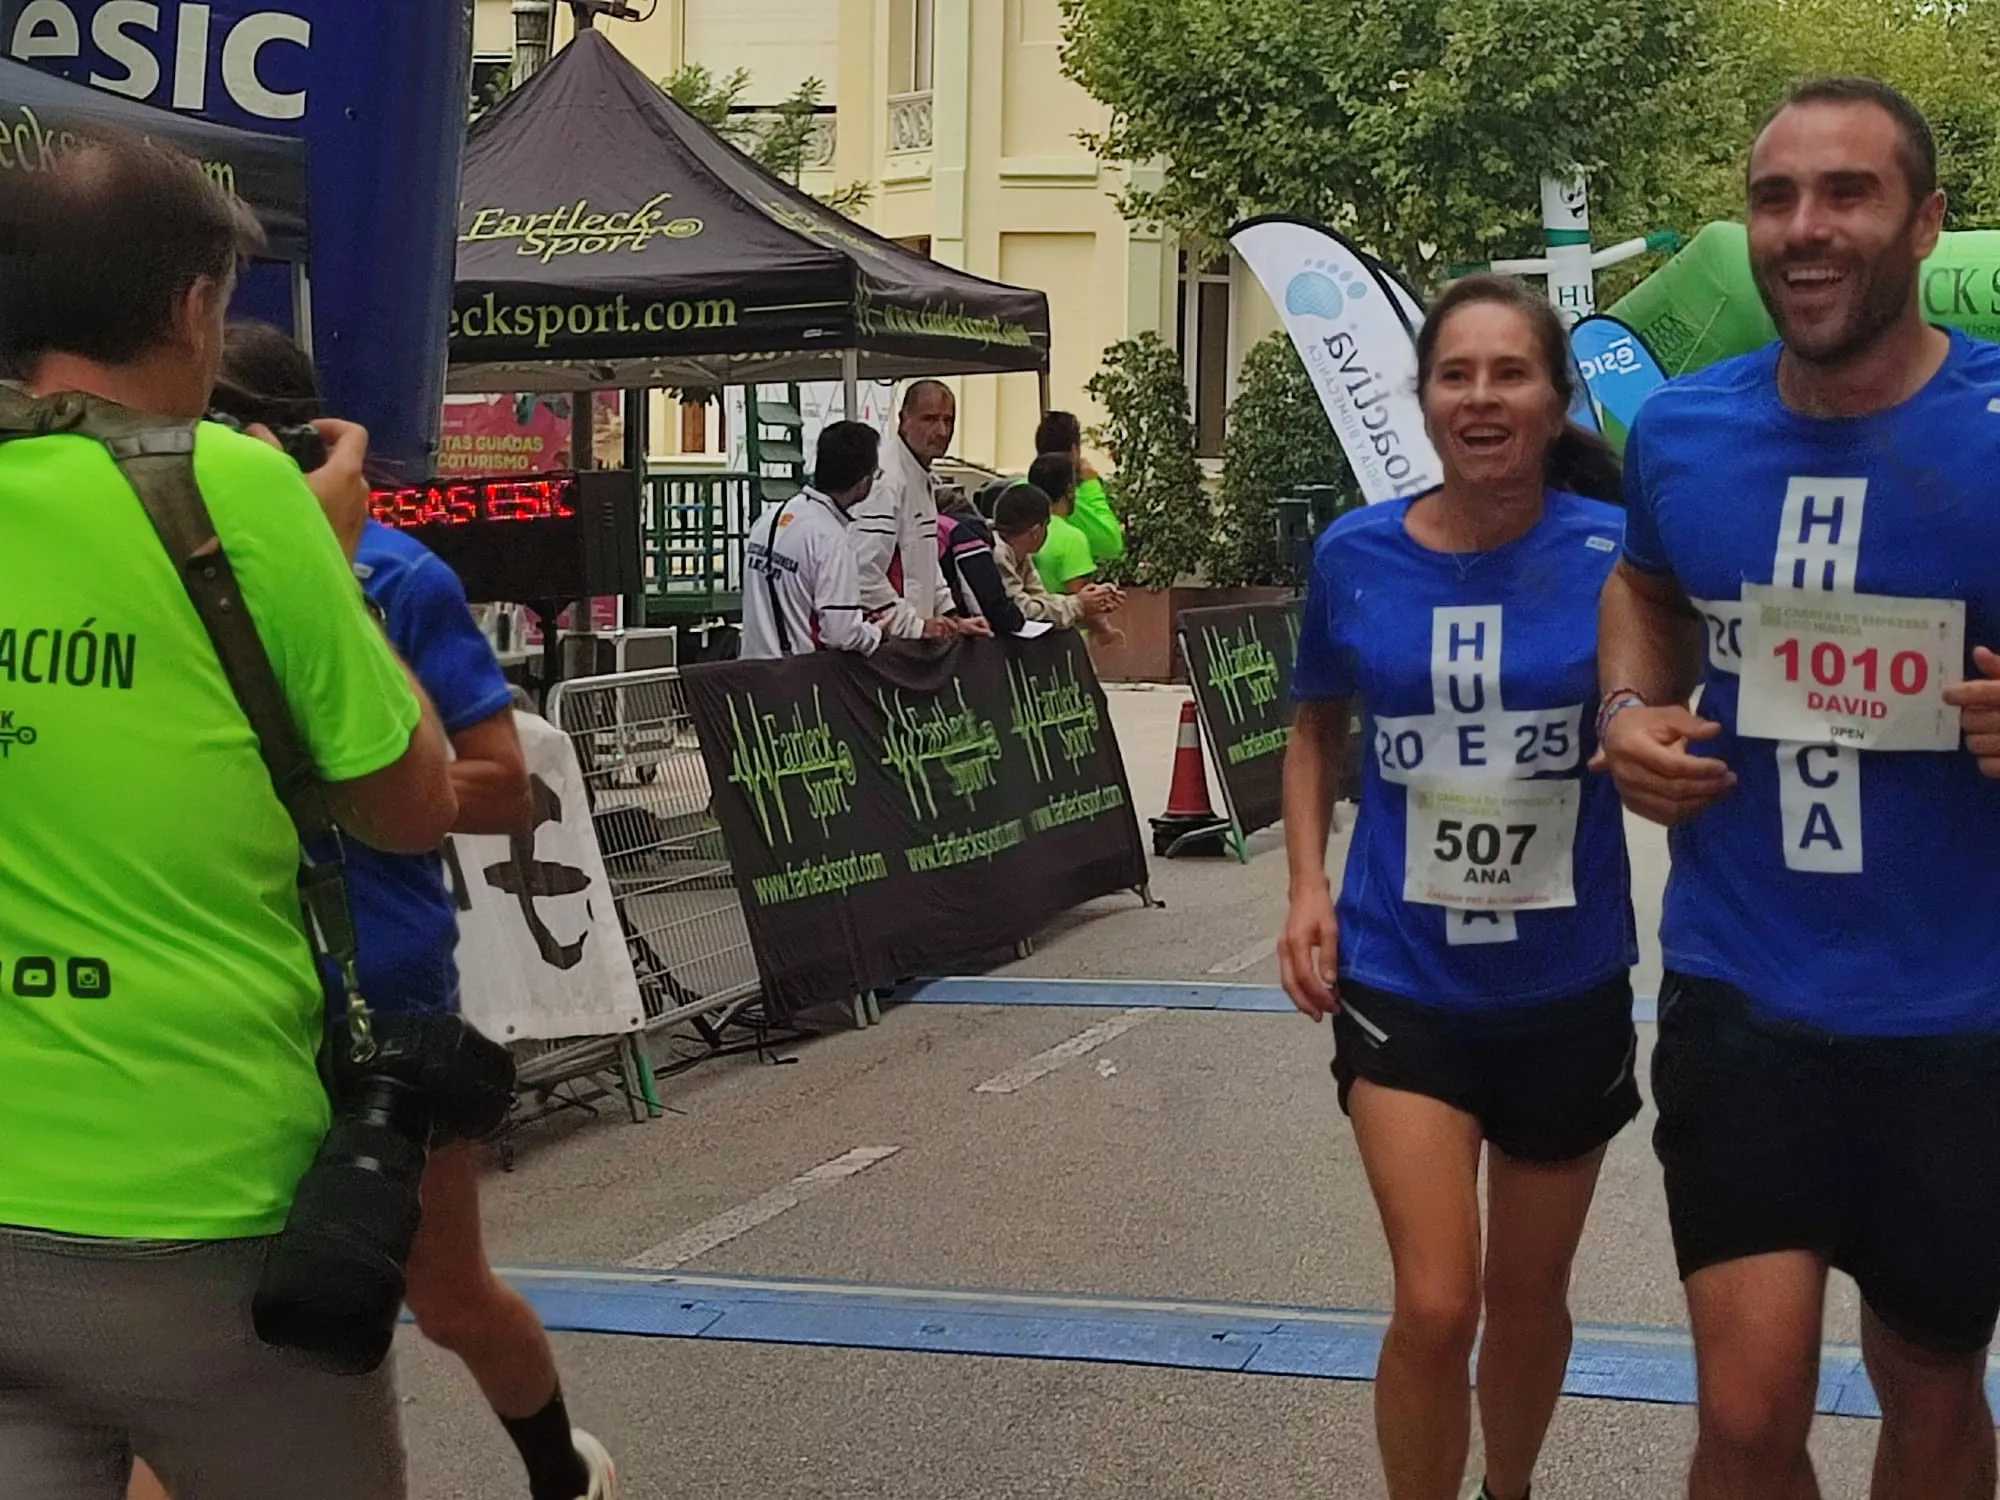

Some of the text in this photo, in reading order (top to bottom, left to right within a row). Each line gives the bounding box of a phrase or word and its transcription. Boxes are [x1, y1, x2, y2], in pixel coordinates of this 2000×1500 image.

[11, 0, 311, 119] esic
[475, 434, 544, 452] GUIADAS
[1773, 637, 1928, 695] 1010
[1807, 691, 1888, 720] DAVID
[1379, 720, 1571, 770] 20 25
[1830, 726, 1865, 740] OPEN
[1433, 819, 1538, 866] 507
[1463, 867, 1512, 885] ANA
